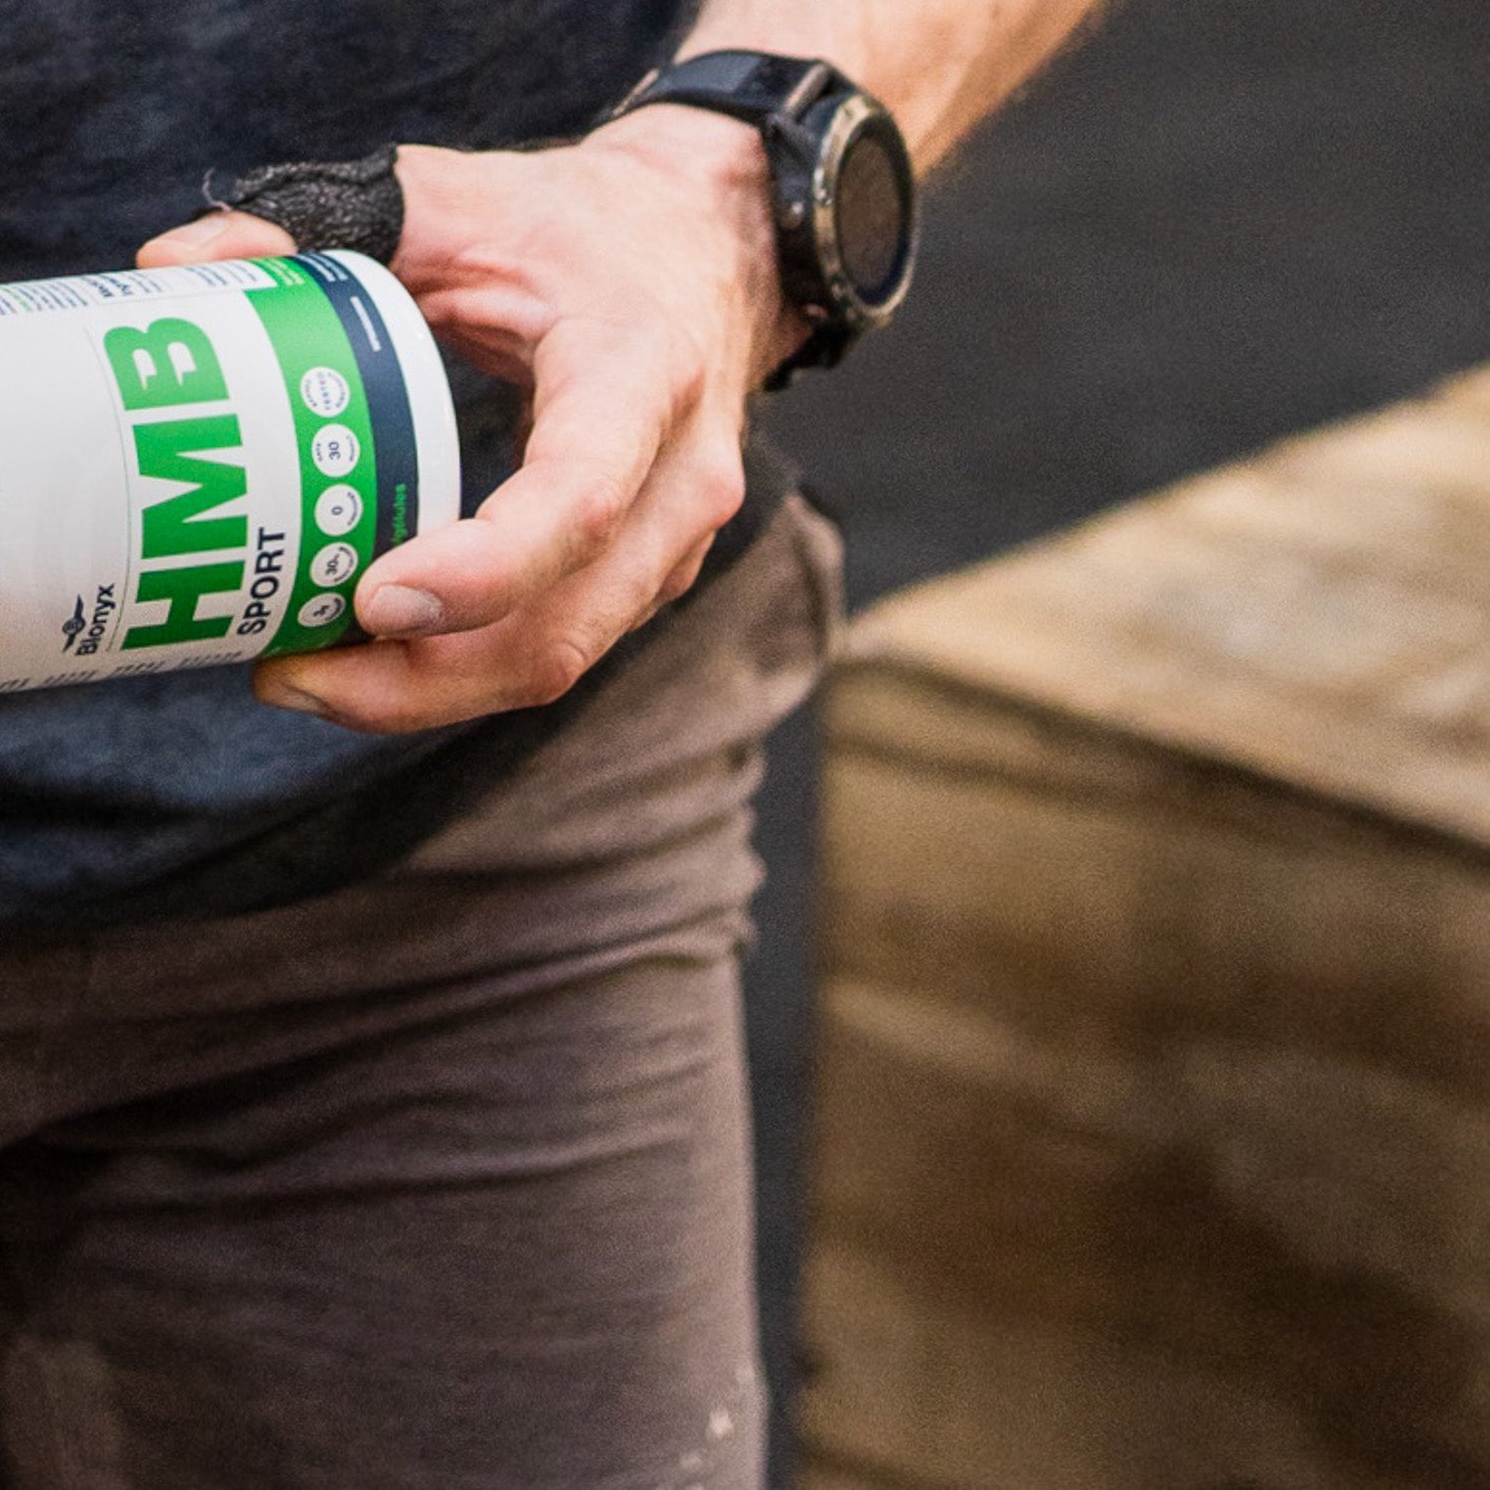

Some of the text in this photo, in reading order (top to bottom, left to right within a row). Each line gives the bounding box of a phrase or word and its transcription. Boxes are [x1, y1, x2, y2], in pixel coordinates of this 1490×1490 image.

[104, 317, 248, 650] HMB
[75, 583, 116, 656] Blonyx
[237, 527, 286, 636] SPORT
